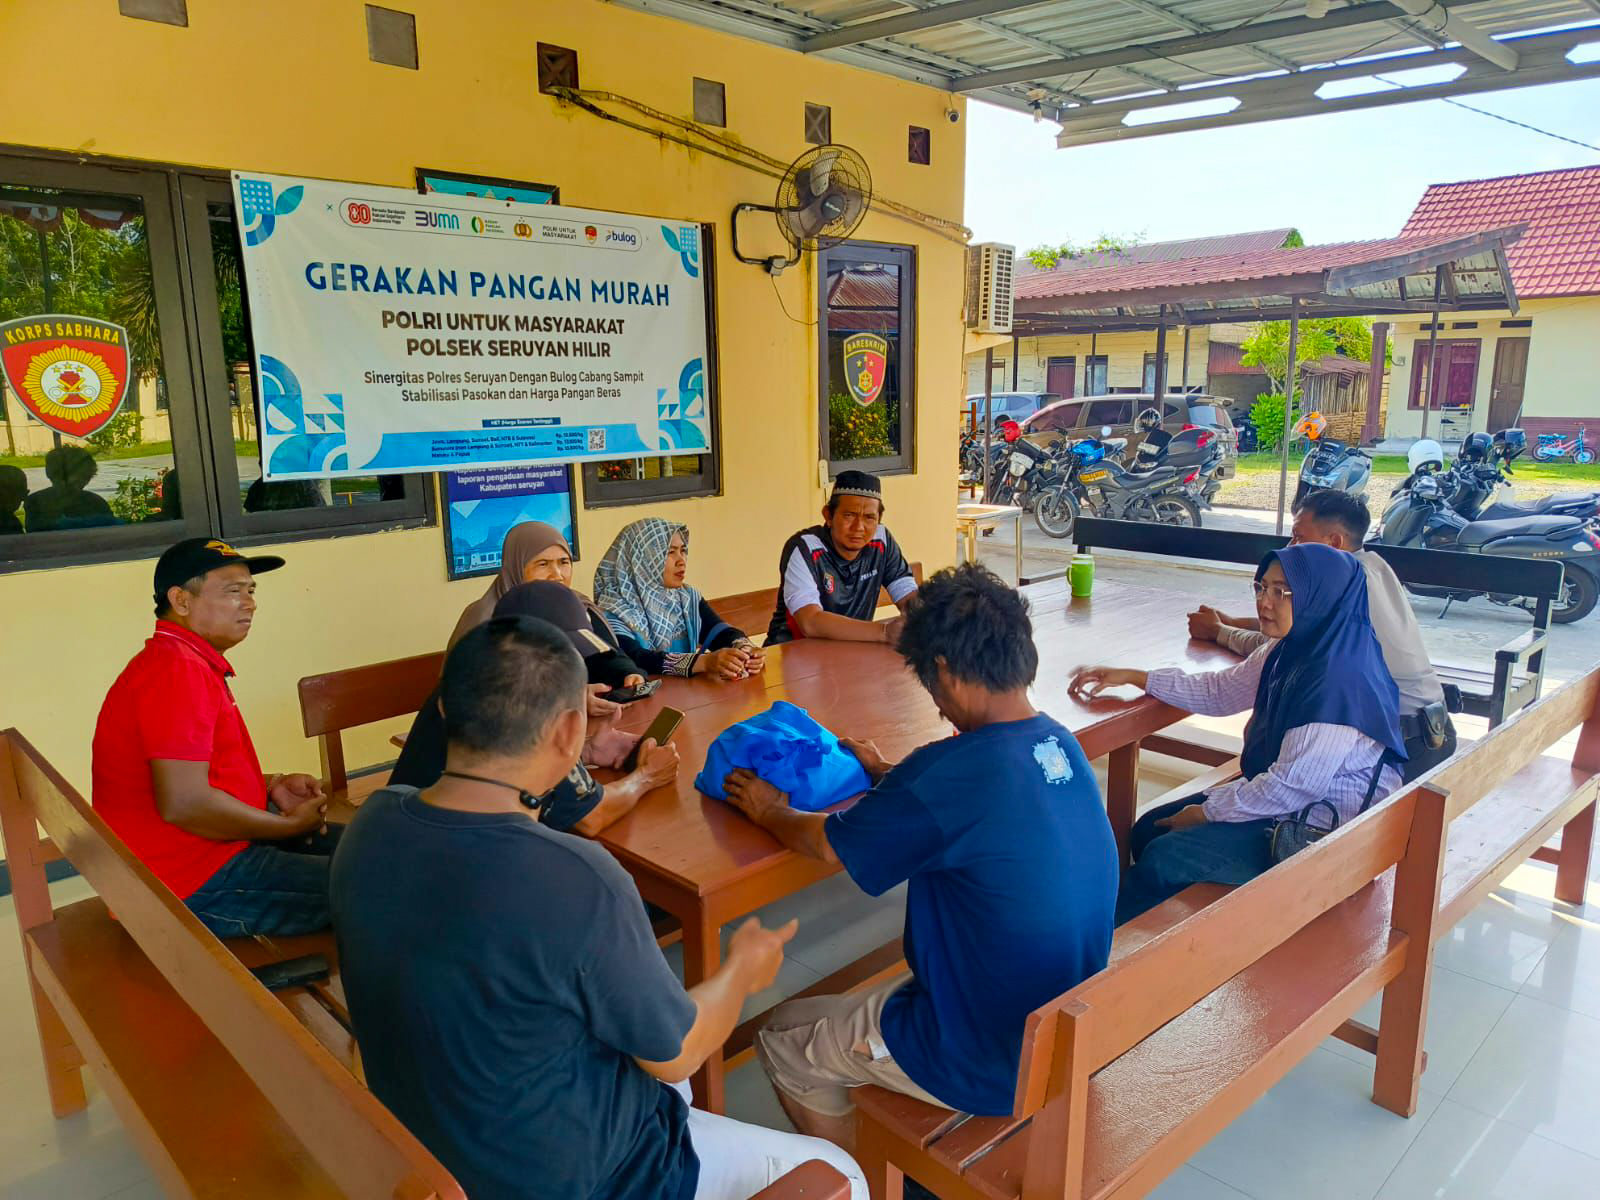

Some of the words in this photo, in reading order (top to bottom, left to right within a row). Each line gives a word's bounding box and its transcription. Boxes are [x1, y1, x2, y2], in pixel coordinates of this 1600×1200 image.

[612, 231, 637, 245] bulog
[305, 261, 458, 297] GERAKAN
[470, 271, 581, 302] PANGAN
[591, 279, 669, 306] MURAH
[382, 310, 443, 330] POLRI
[446, 313, 511, 332] UNTUK
[514, 315, 625, 335] MASYARAKAT
[4, 322, 53, 345] KORPS
[55, 322, 119, 344] SABHARA
[406, 338, 483, 357] POLSEK
[487, 339, 569, 358] SERUYAN
[572, 341, 611, 358] HILIR
[364, 370, 425, 387] Sinergitas
[427, 371, 462, 384] Polres
[464, 371, 508, 386] Seruyan
[509, 371, 548, 385] Dengan
[550, 371, 577, 385] Bulog
[579, 371, 612, 385] Cabang
[613, 370, 644, 384] Sampit
[401, 388, 460, 402] Stabilisasi
[462, 388, 507, 401] Pasokan
[508, 388, 528, 400] dan
[530, 388, 559, 402] Harga
[561, 387, 595, 401] Pangan
[597, 386, 622, 398] Beras
[457, 475, 486, 486] laporan
[486, 472, 525, 483] pengaduan
[525, 469, 563, 479] masyarakat
[479, 482, 518, 492] Kabupaten
[518, 480, 545, 490] seruyan
